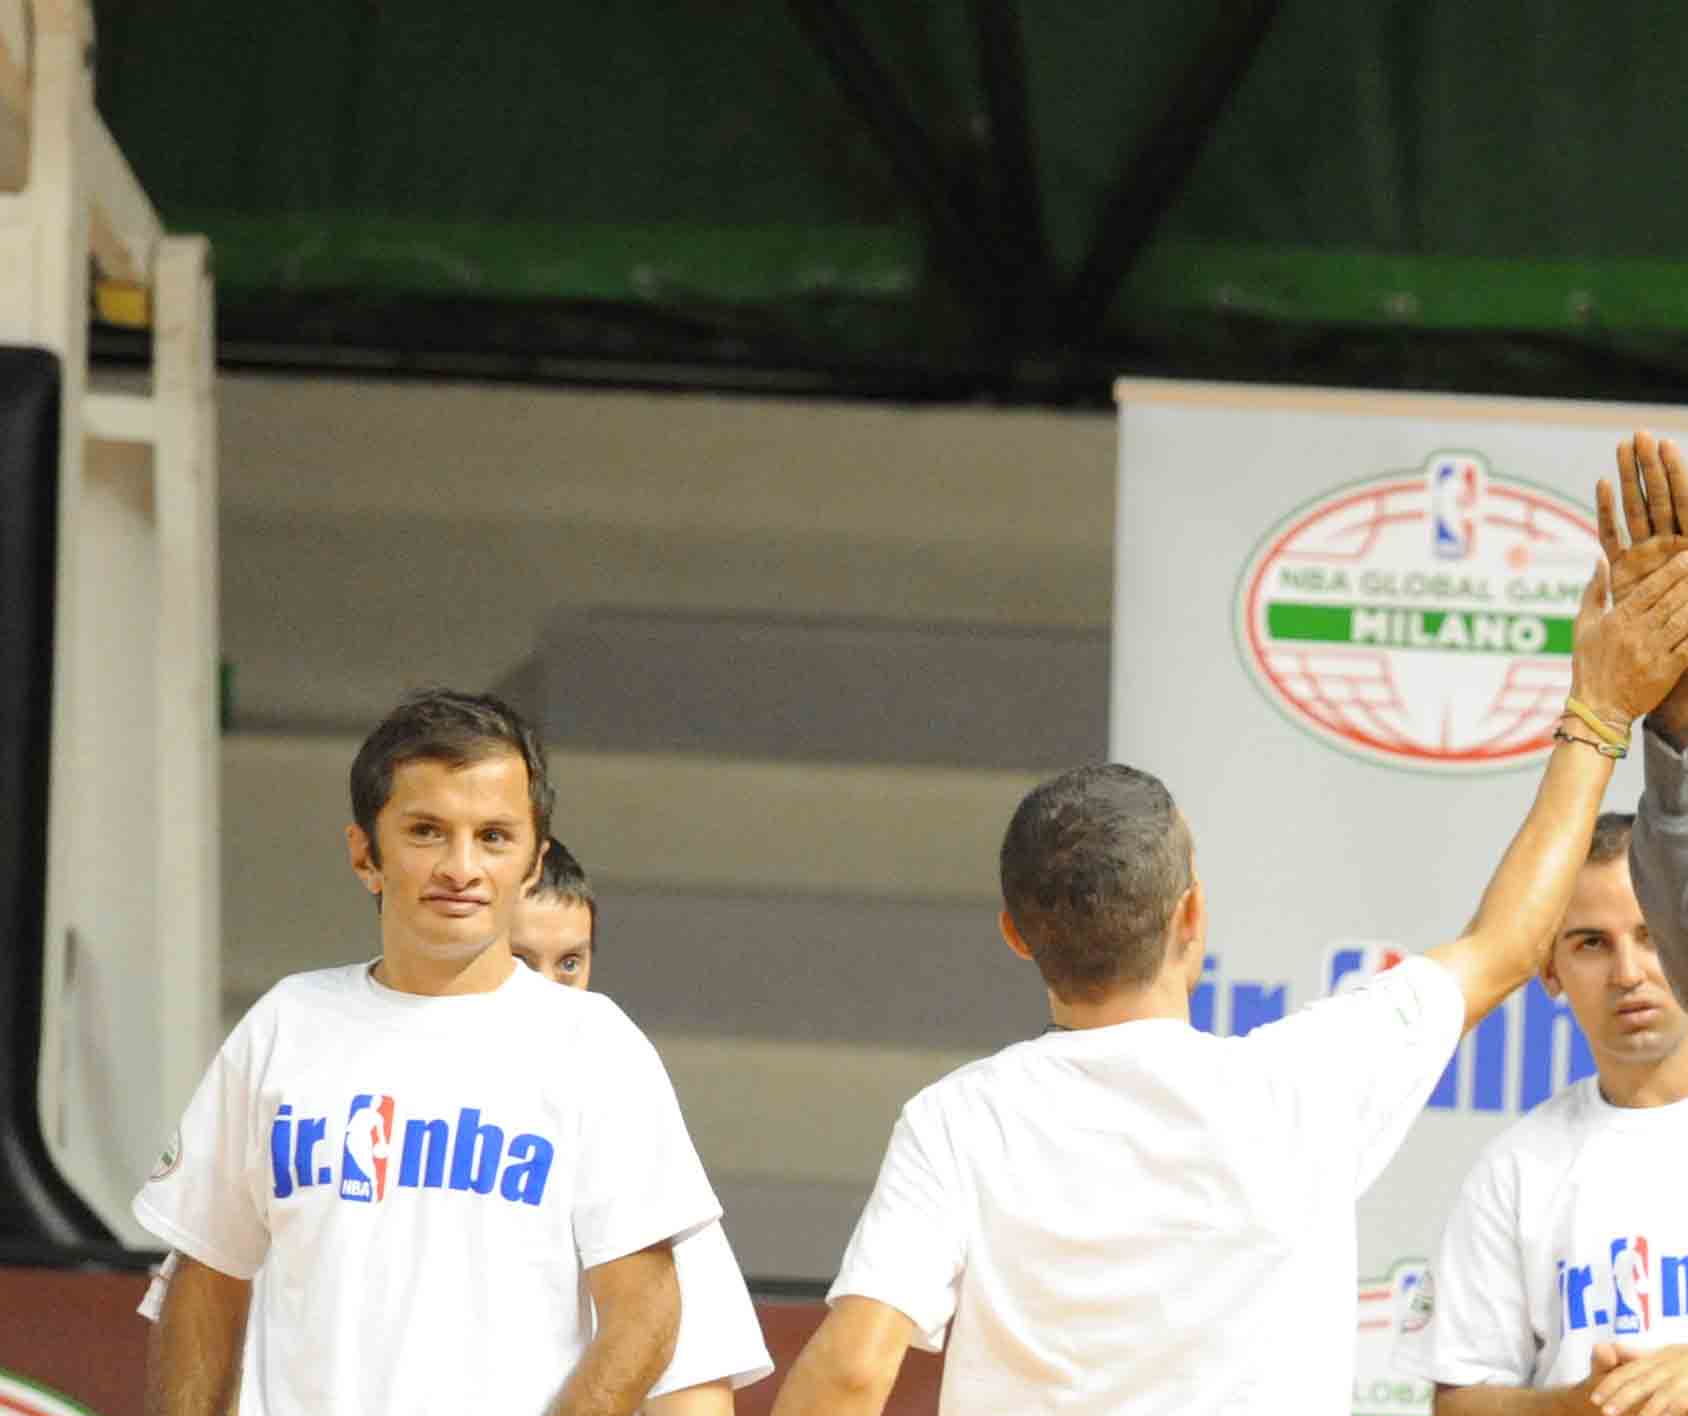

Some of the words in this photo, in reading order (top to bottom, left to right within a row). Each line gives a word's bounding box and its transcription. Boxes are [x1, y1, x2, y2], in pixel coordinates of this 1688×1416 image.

[1280, 566, 1348, 592] NBA
[1359, 570, 1495, 600] GLOBAL
[1353, 608, 1546, 653] MILANO
[271, 1103, 331, 1198] jr.
[397, 1106, 555, 1207] nba
